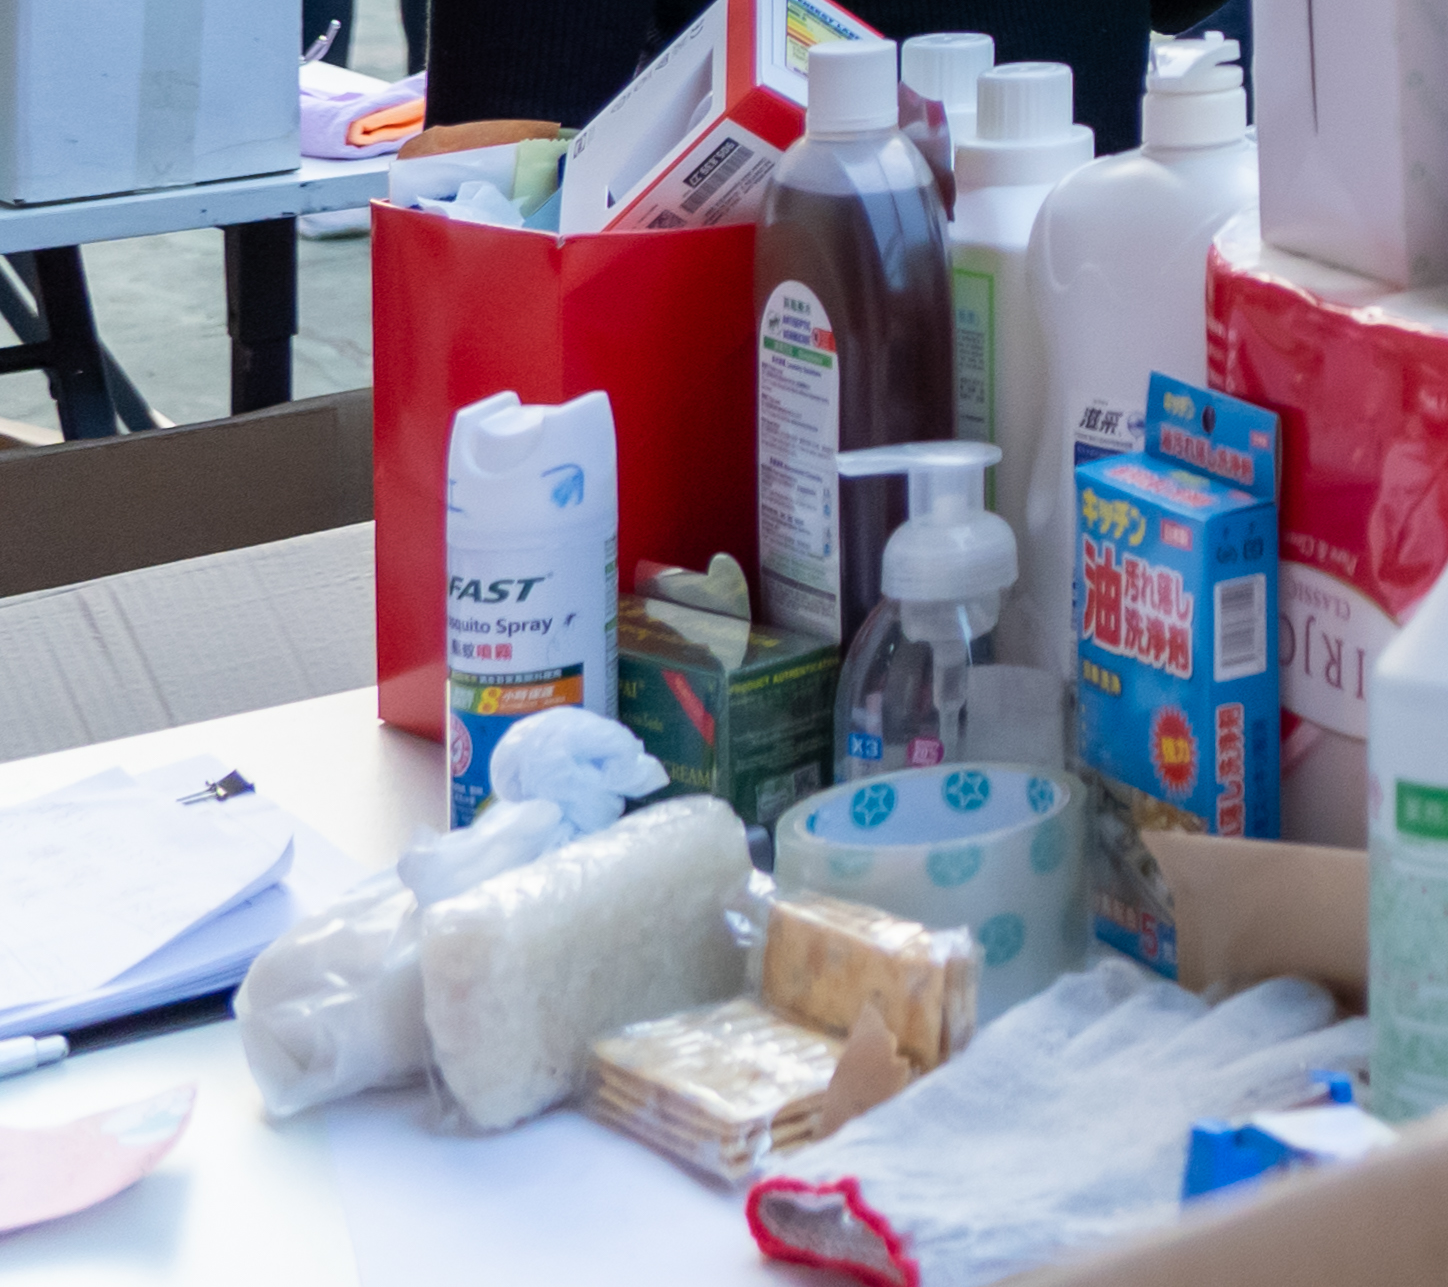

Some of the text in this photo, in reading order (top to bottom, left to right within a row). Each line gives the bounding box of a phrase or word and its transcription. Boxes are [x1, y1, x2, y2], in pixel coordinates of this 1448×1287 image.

[1082, 488, 1146, 546] キッチン
[1289, 580, 1351, 622] CLASSIC
[495, 616, 553, 637] Spray
